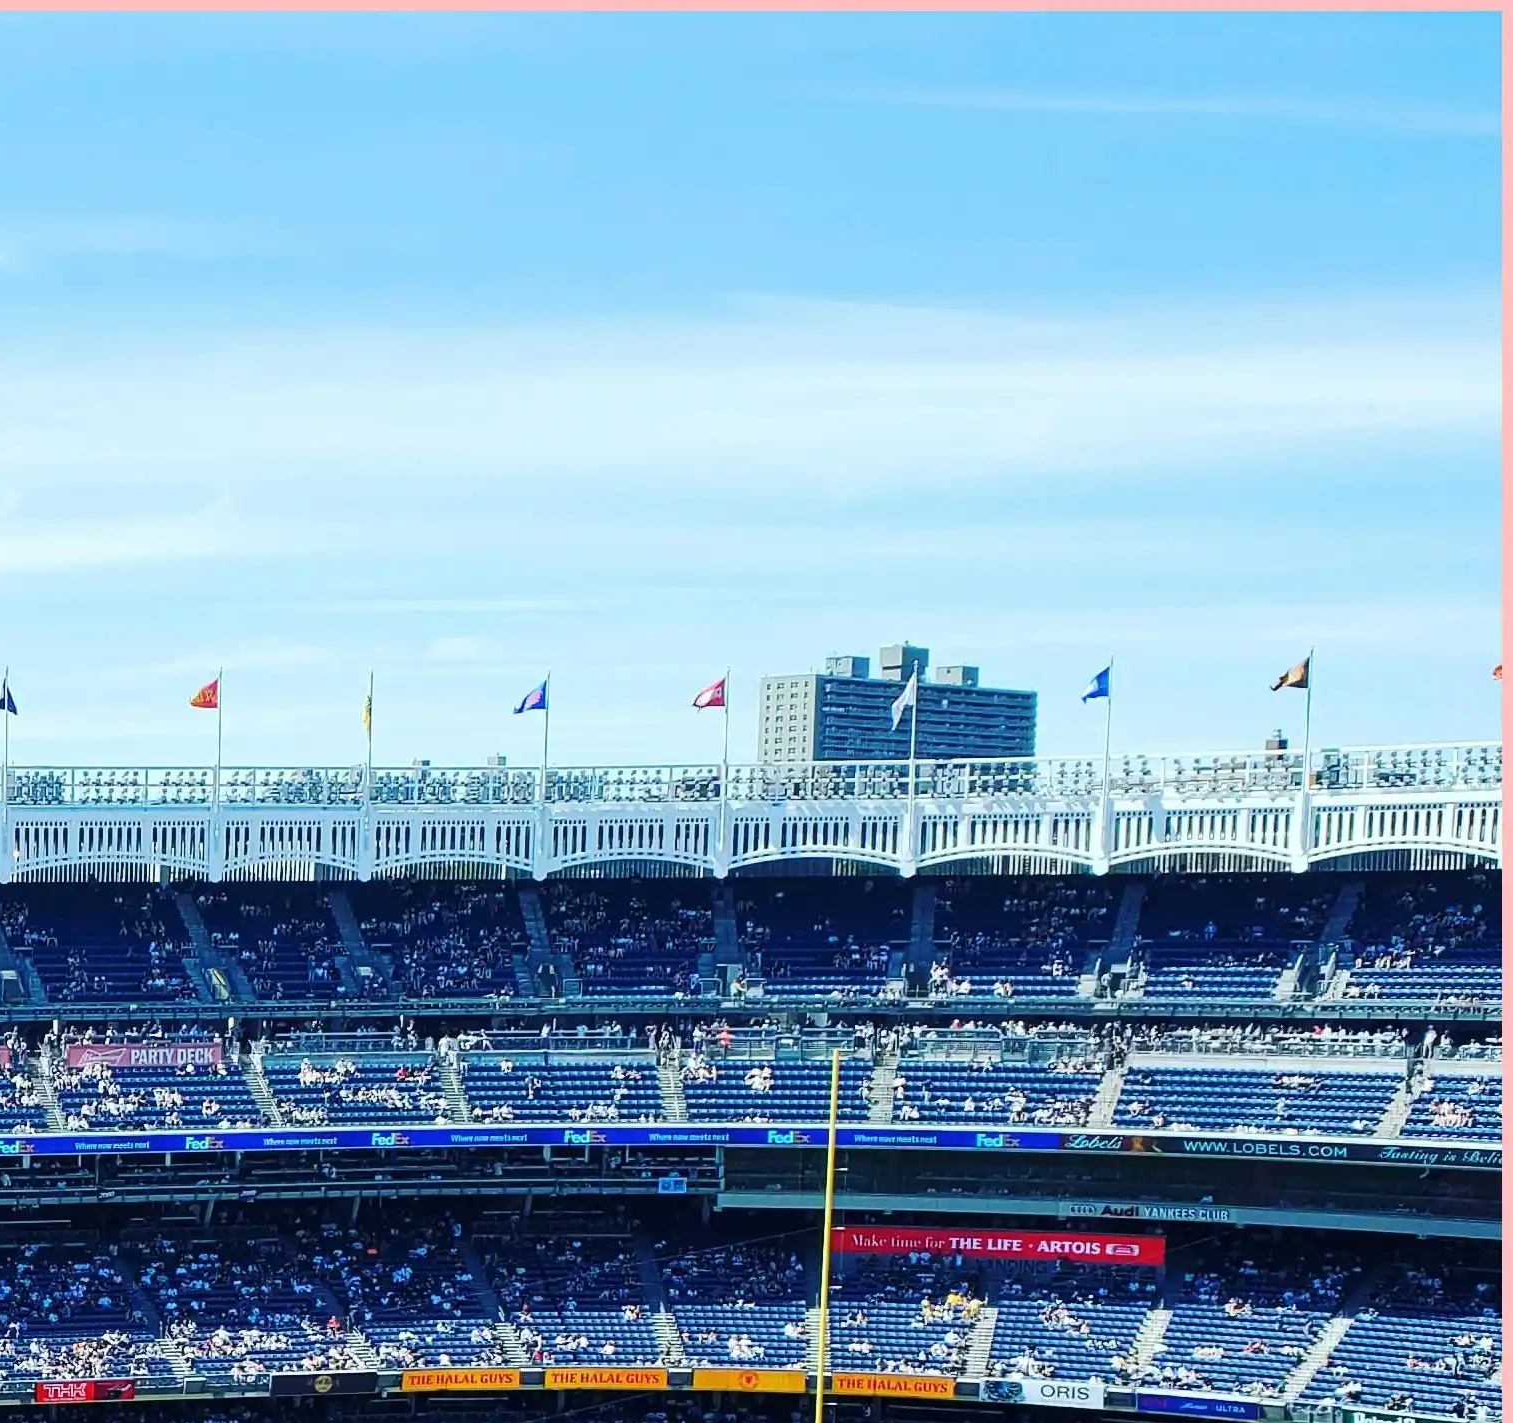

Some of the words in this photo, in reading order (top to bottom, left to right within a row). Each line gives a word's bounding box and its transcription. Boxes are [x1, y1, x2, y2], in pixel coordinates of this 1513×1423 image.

[131, 1048, 174, 1065] PARTY
[177, 1048, 213, 1064] DECK
[186, 1136, 224, 1149] FedEx
[371, 1133, 409, 1146] FedEx
[564, 1129, 606, 1143] FedEx
[768, 1131, 810, 1144] FedEx
[976, 1133, 1019, 1147] FedEx
[1065, 1134, 1122, 1149] Lobels
[1183, 1141, 1347, 1158] WWW.LOBELS.COM
[1100, 1205, 1139, 1217] Audi
[1144, 1206, 1195, 1219] YANKEES
[1198, 1208, 1228, 1220] CLUB
[852, 1234, 887, 1247] Make
[891, 1235, 921, 1248] time
[925, 1236, 945, 1249] for
[949, 1238, 982, 1250] THE
[987, 1238, 1023, 1251] LIFE
[1037, 1240, 1101, 1255] ARTOIS
[409, 1374, 434, 1385] THE
[436, 1374, 477, 1385] HALAL
[480, 1373, 513, 1384] GUYS
[552, 1373, 576, 1384] THE
[580, 1373, 623, 1384] HALAL
[626, 1373, 659, 1384] GUYS
[838, 1378, 864, 1389] THE
[867, 1379, 911, 1391] HALAL
[914, 1381, 948, 1393] GUYS
[43, 1383, 87, 1397] THK
[1040, 1385, 1089, 1400] ORIS
